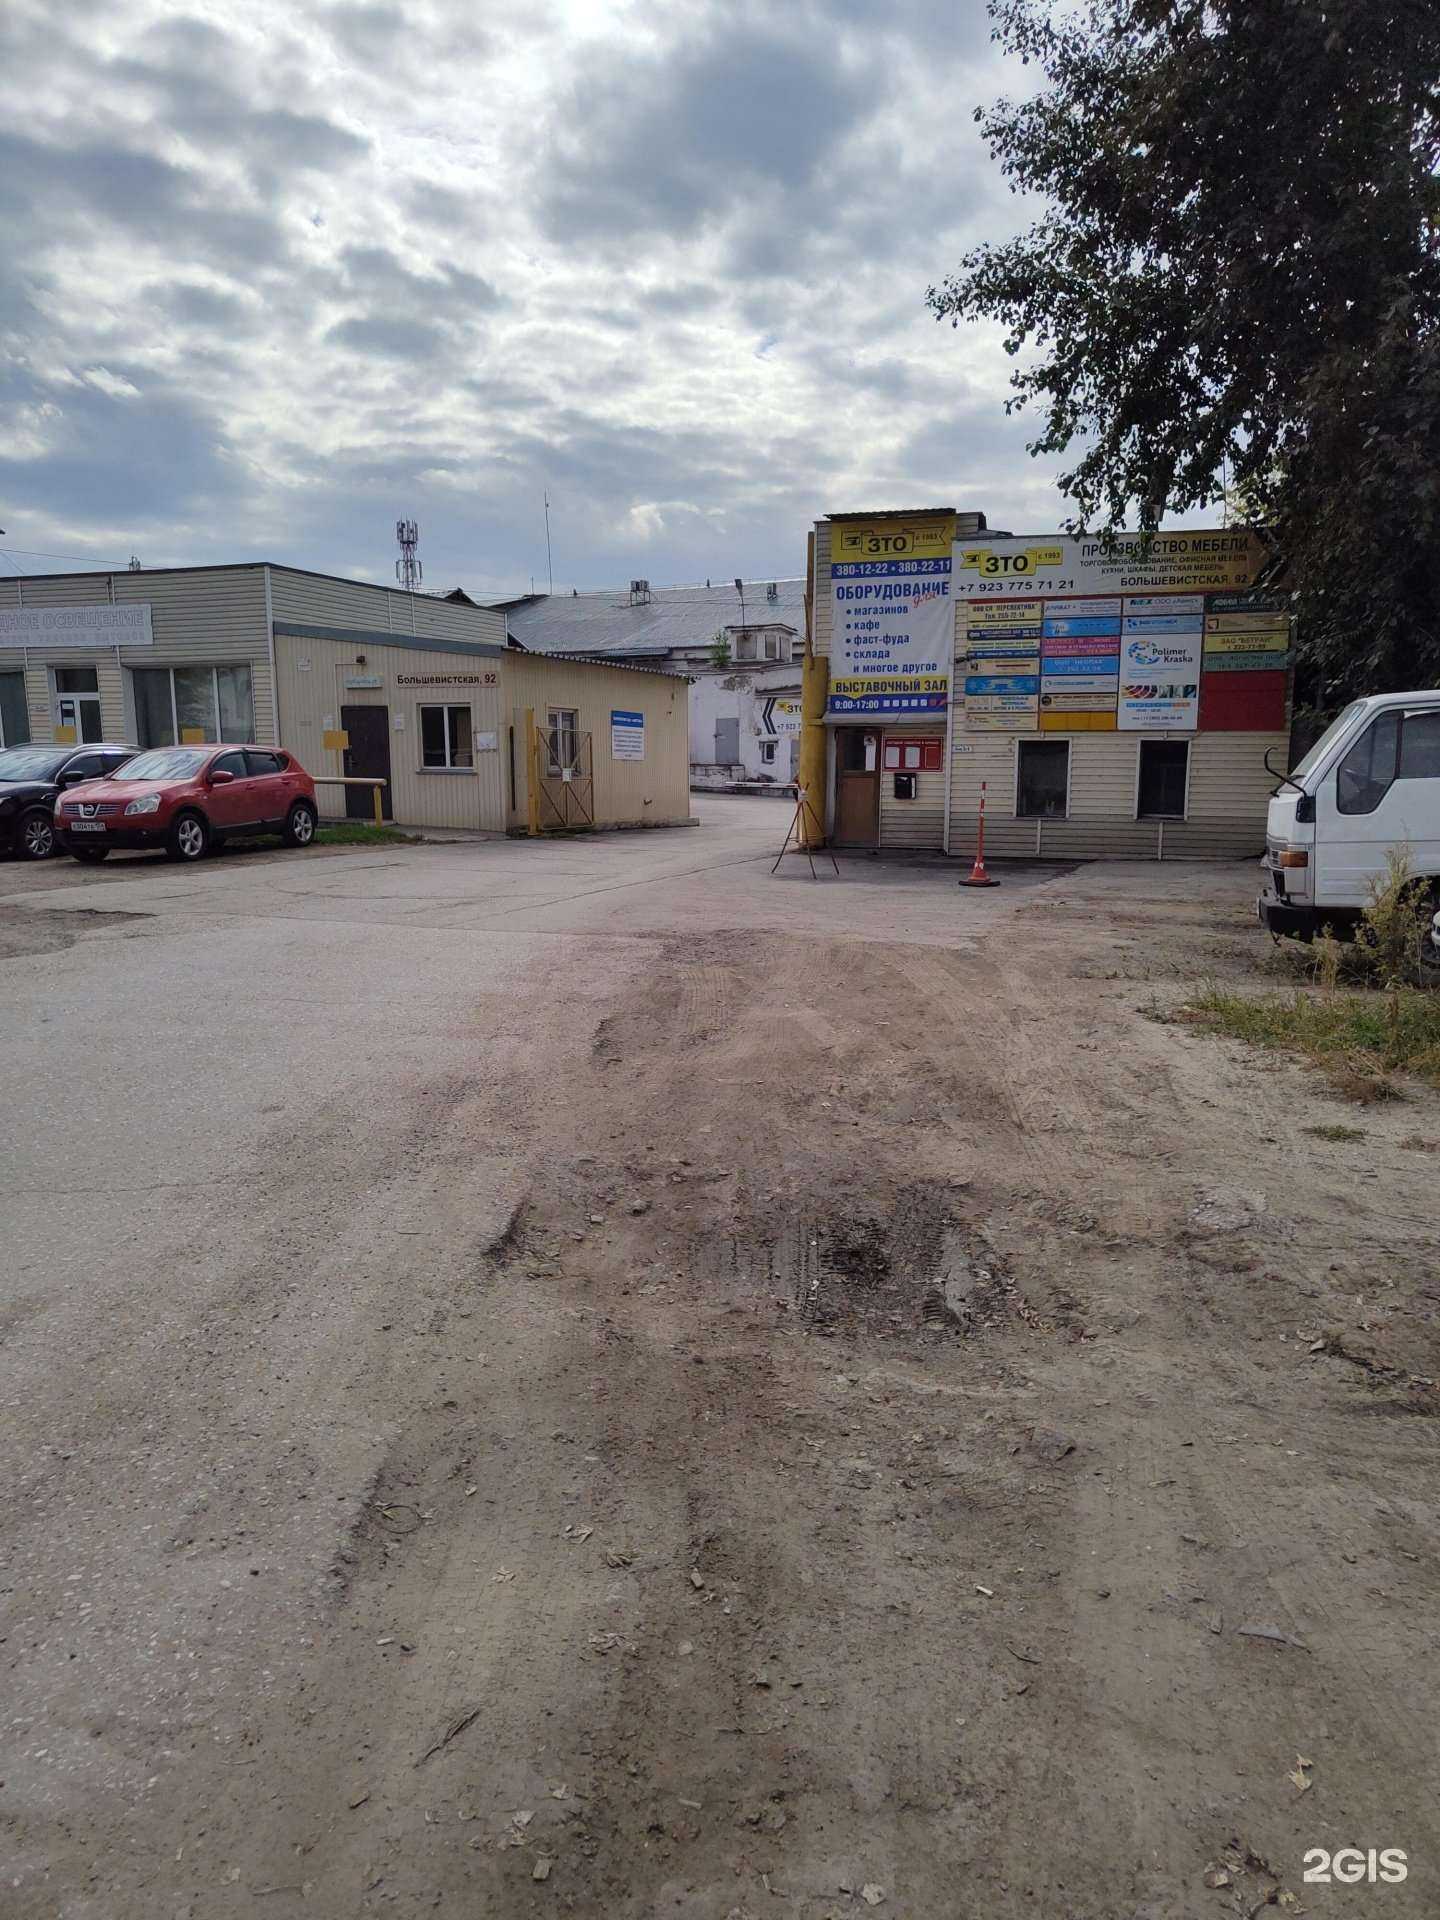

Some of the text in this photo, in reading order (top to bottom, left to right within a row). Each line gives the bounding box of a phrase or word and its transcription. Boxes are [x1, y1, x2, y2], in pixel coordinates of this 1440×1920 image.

[1191, 537, 1248, 552] МЕБЕЛИ
[836, 560, 951, 575] 380-12-22 380-22-11
[985, 555, 1028, 573] ЗТО
[1234, 575, 1247, 584] 92
[836, 581, 950, 600] ОБОРУДОВАНИЕ
[958, 580, 1074, 592] +7 923 775 71 21
[854, 605, 908, 616] магазинов
[854, 620, 880, 631] кафе
[853, 633, 910, 646] фаст-фуда
[853, 649, 890, 660] склада
[1152, 647, 1187, 656] Polimer
[1163, 655, 1193, 664] Kraska
[853, 662, 937, 675] и многое другое
[397, 673, 497, 685] Большевистская, 92
[835, 678, 948, 693] ВЫСТАВОЧНЫЙ ЗАЛ
[834, 700, 880, 710] 9:00-17:00
